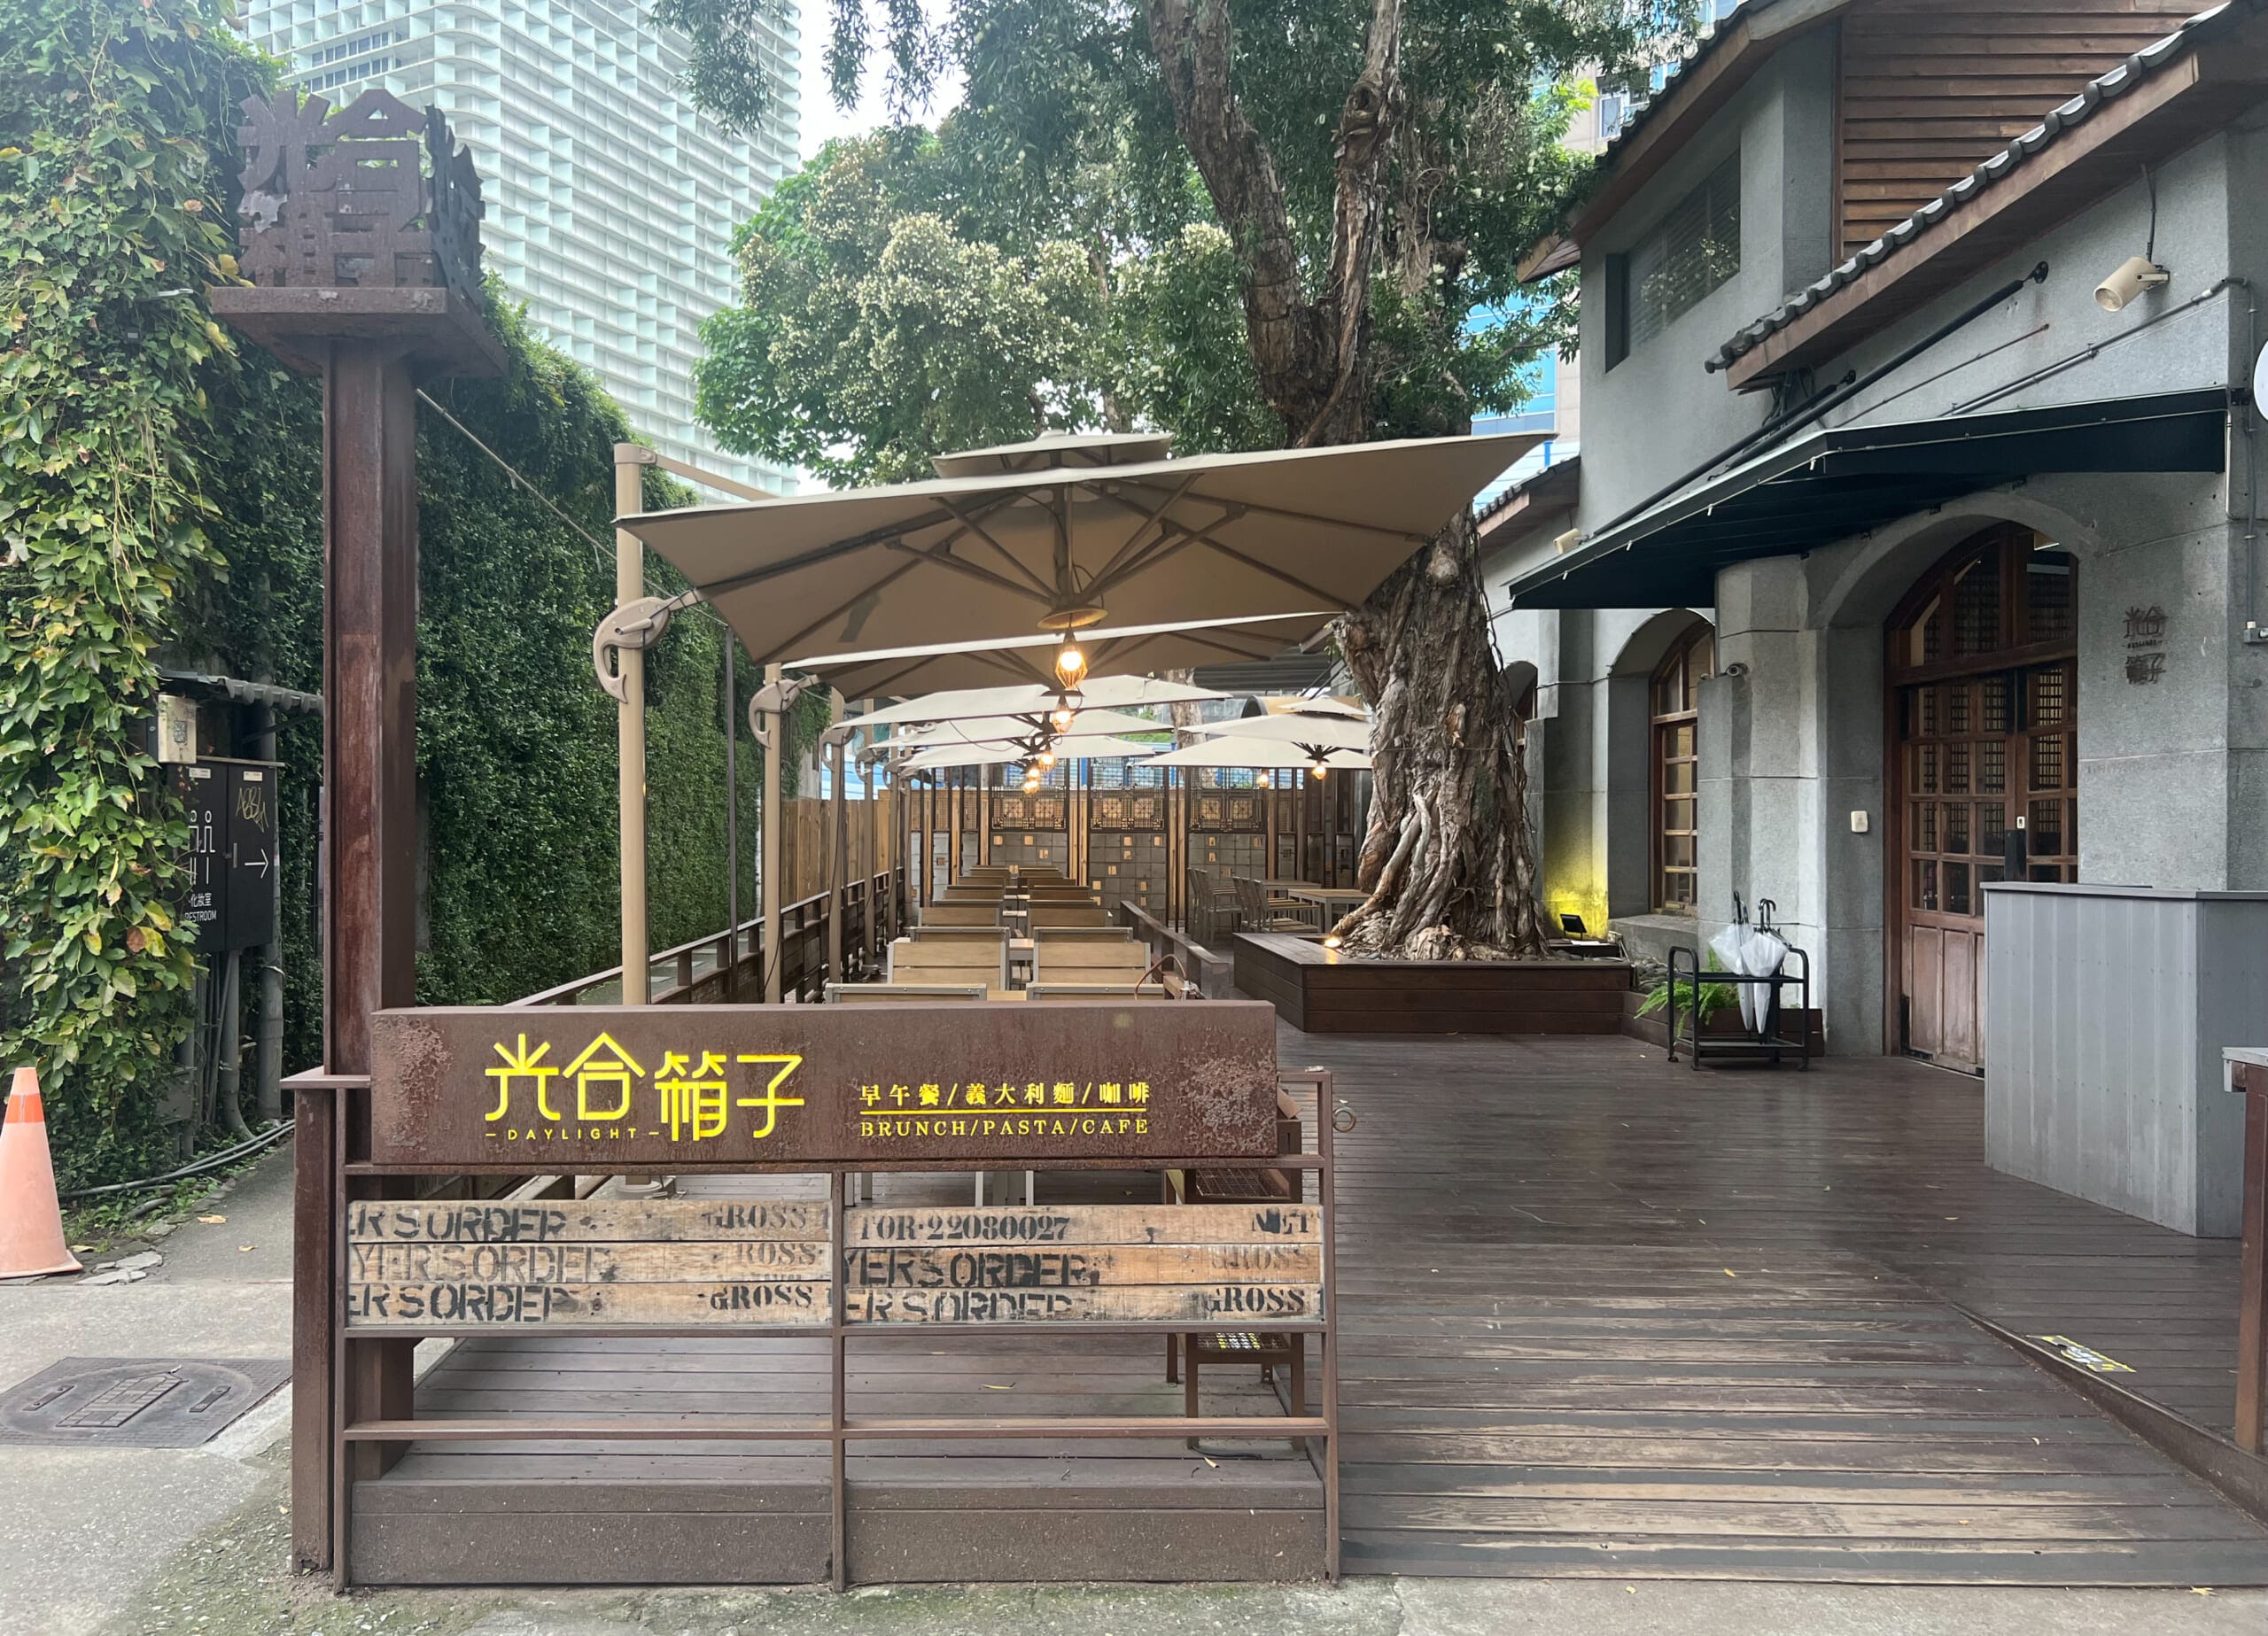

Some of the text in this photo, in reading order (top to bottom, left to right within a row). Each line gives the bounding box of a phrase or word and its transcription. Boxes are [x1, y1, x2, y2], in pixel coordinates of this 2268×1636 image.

[485, 1031, 805, 1142] 光合箱子
[508, 1128, 638, 1141] DAYLIGHT
[710, 1284, 812, 1311] GROSS
